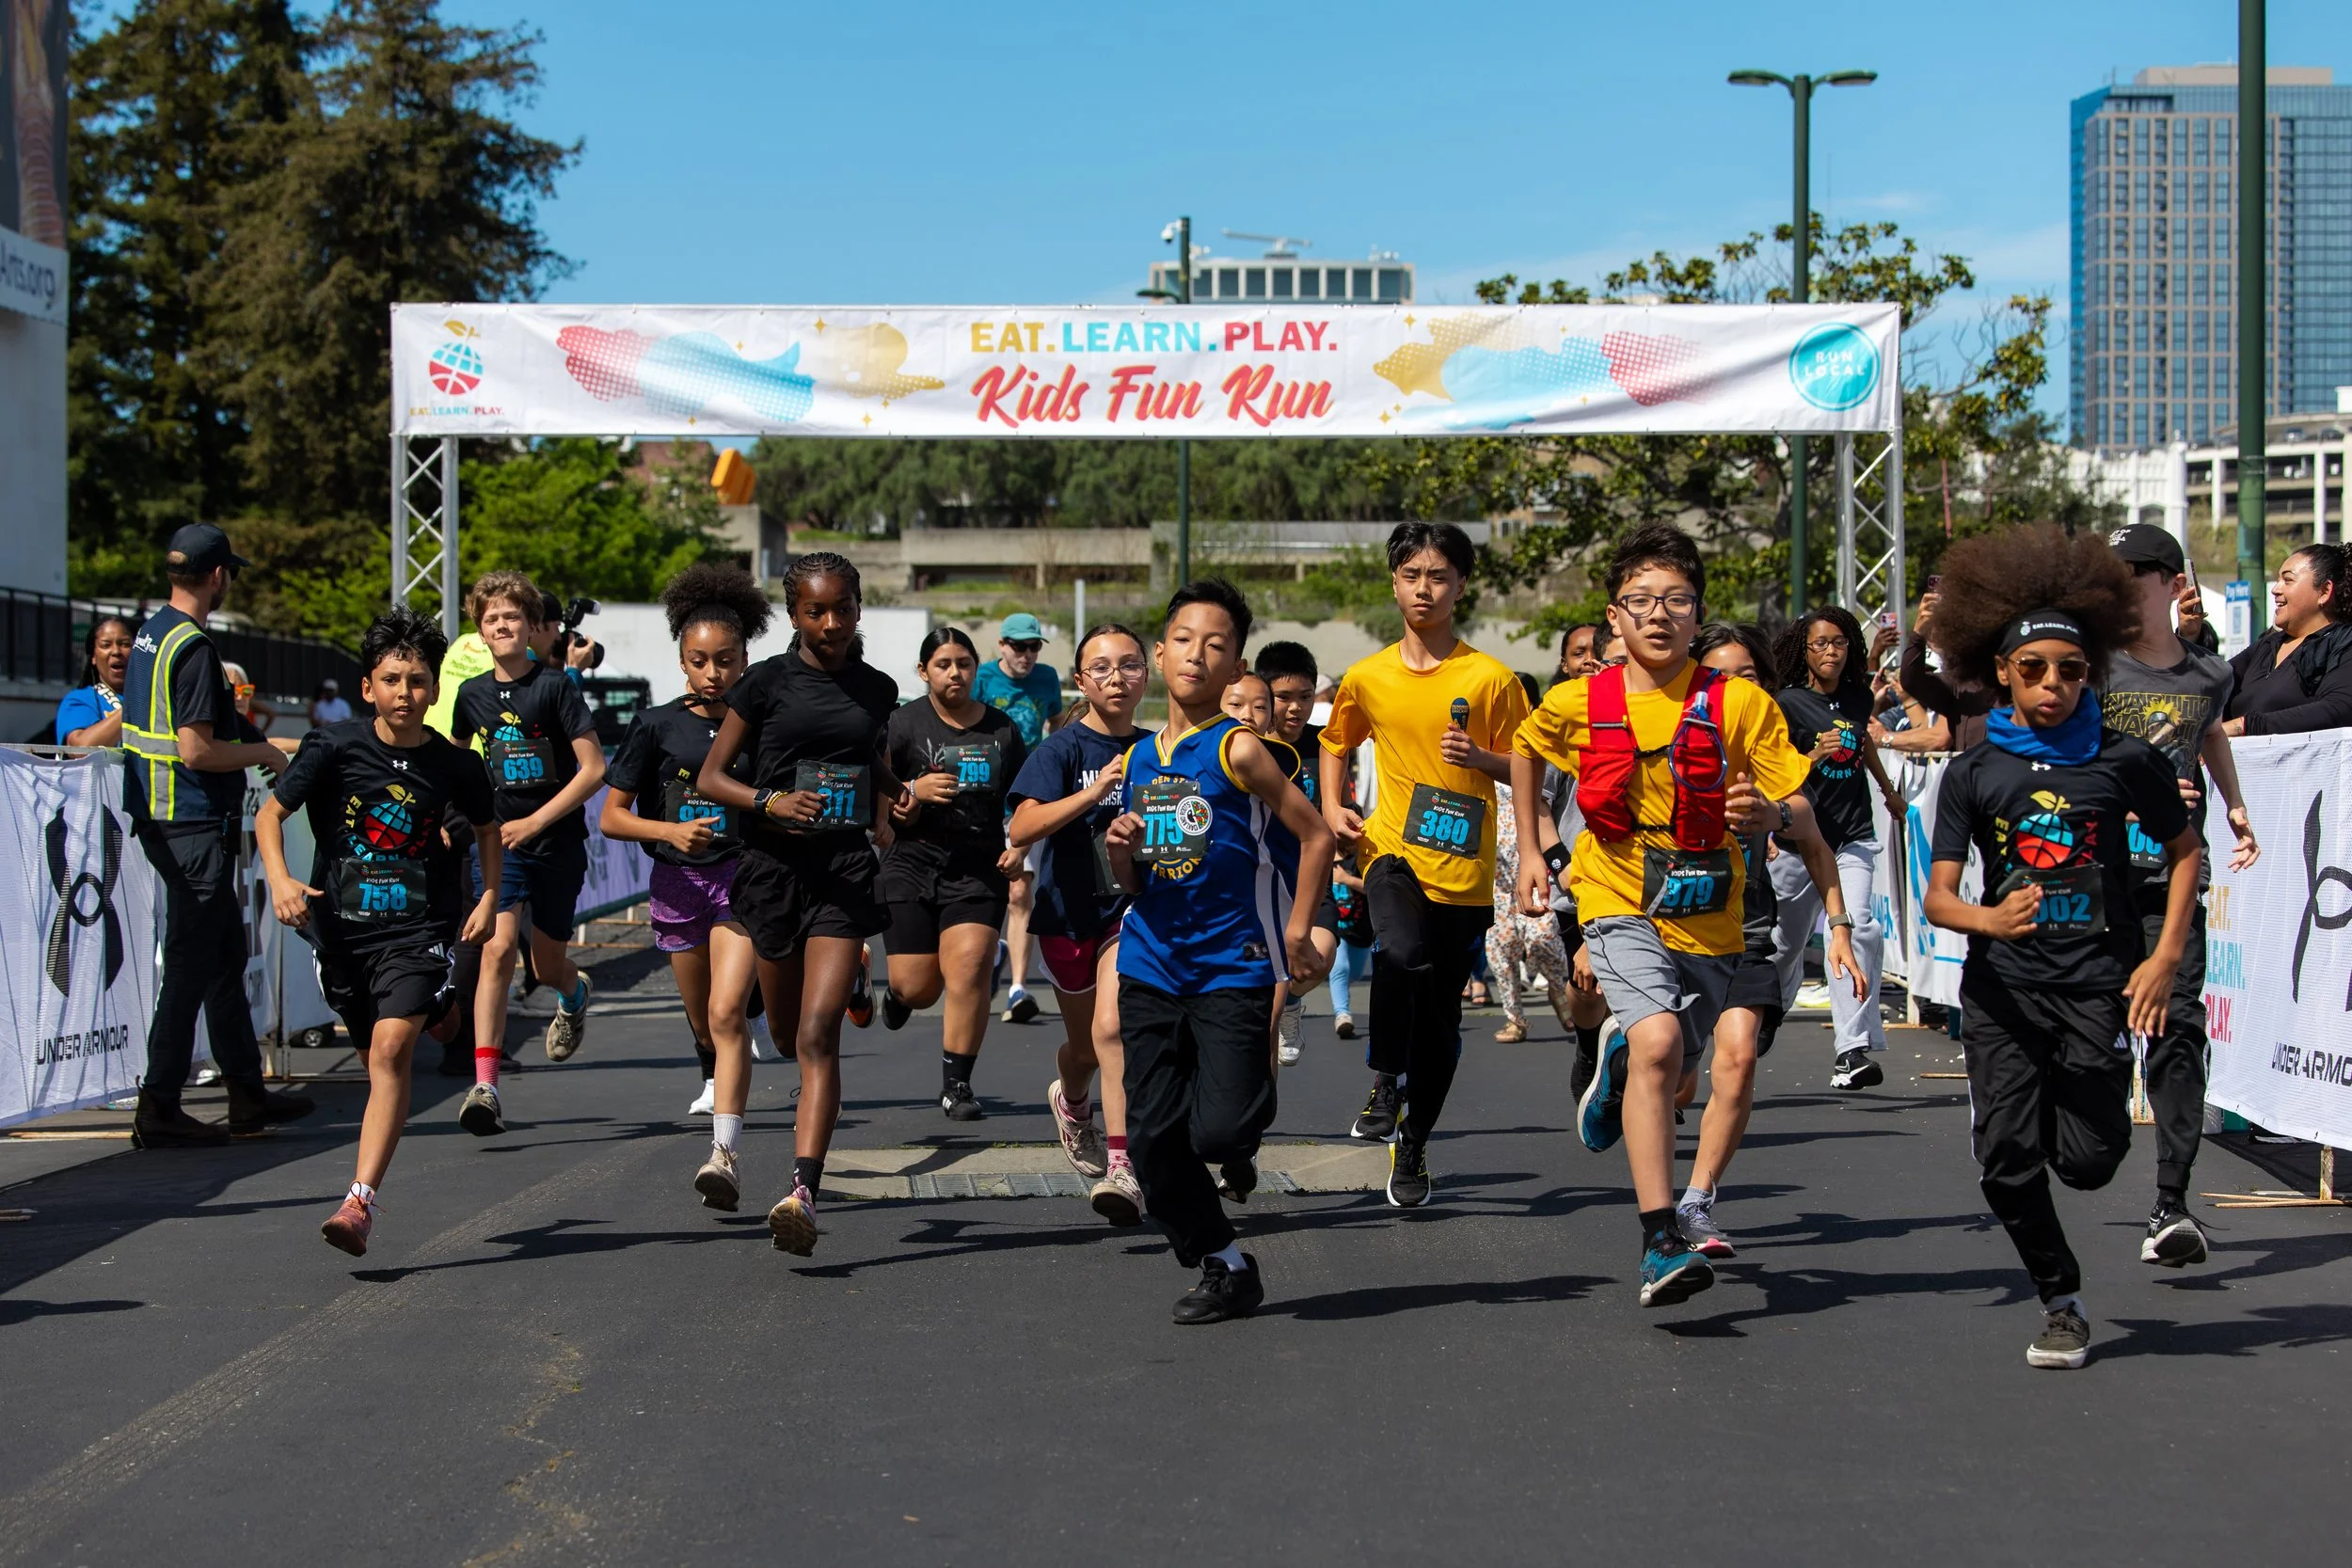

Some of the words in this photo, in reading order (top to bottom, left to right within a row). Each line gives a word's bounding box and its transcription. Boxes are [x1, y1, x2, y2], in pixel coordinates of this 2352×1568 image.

[970, 322, 1056, 353] EAT.
[1062, 322, 1216, 352] LEARN.
[1224, 321, 1338, 352] PLAY.
[1804, 364, 1865, 377] LOCAL
[1816, 351, 1852, 363] RUN
[970, 363, 1090, 429] Kids
[1106, 364, 1205, 423] Fun
[1220, 362, 1335, 428] Run
[503, 756, 544, 781] 639
[957, 762, 991, 783] 799
[1143, 813, 1184, 846] 775
[1420, 810, 1470, 845] 380
[358, 883, 407, 911] 758
[1662, 876, 1714, 908] 379
[2208, 885, 2231, 931] EAT.
[2205, 939, 2246, 990] LEARN.
[2205, 992, 2232, 1043] PLAY.
[37, 1034, 81, 1066] UNDER
[83, 1024, 128, 1057] ARMOUR
[2271, 1041, 2301, 1077] UNDER
